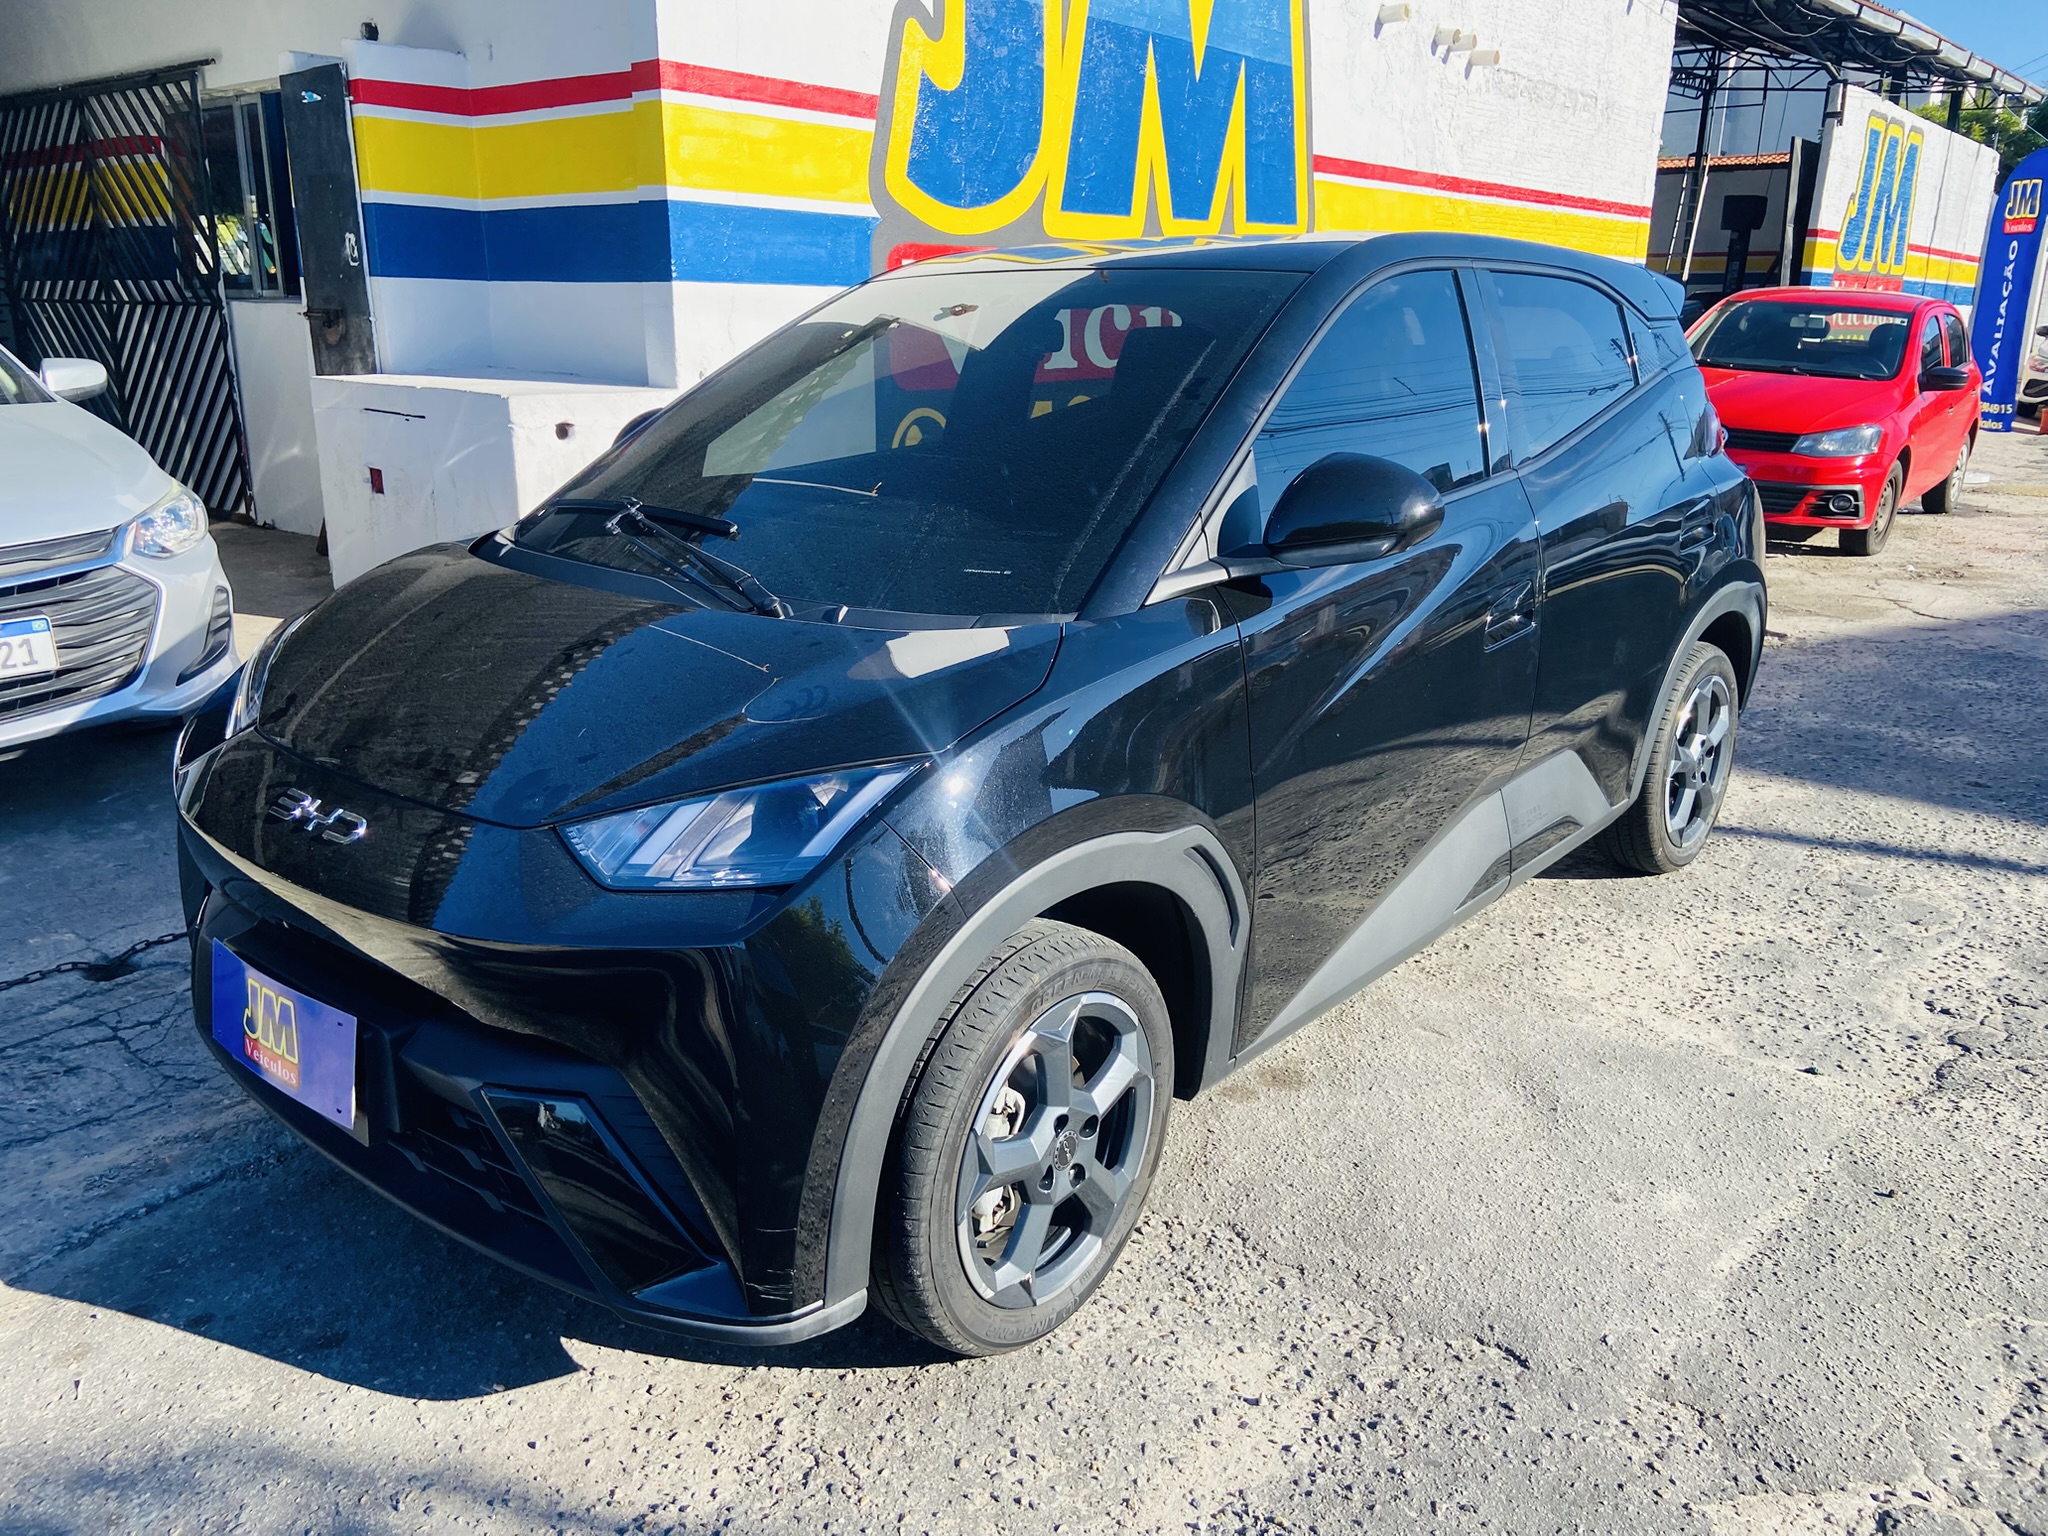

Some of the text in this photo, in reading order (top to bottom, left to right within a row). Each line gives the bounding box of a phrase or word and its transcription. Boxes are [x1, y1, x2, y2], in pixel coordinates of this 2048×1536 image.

[885, 0, 1308, 237] JM
[1837, 113, 1924, 276] JM
[2004, 179, 2043, 220] JM
[1982, 239, 2019, 396] AVALIAÇÃO
[268, 787, 368, 845] BYD
[243, 978, 299, 1065] JM
[245, 1037, 297, 1085] Veiculos
